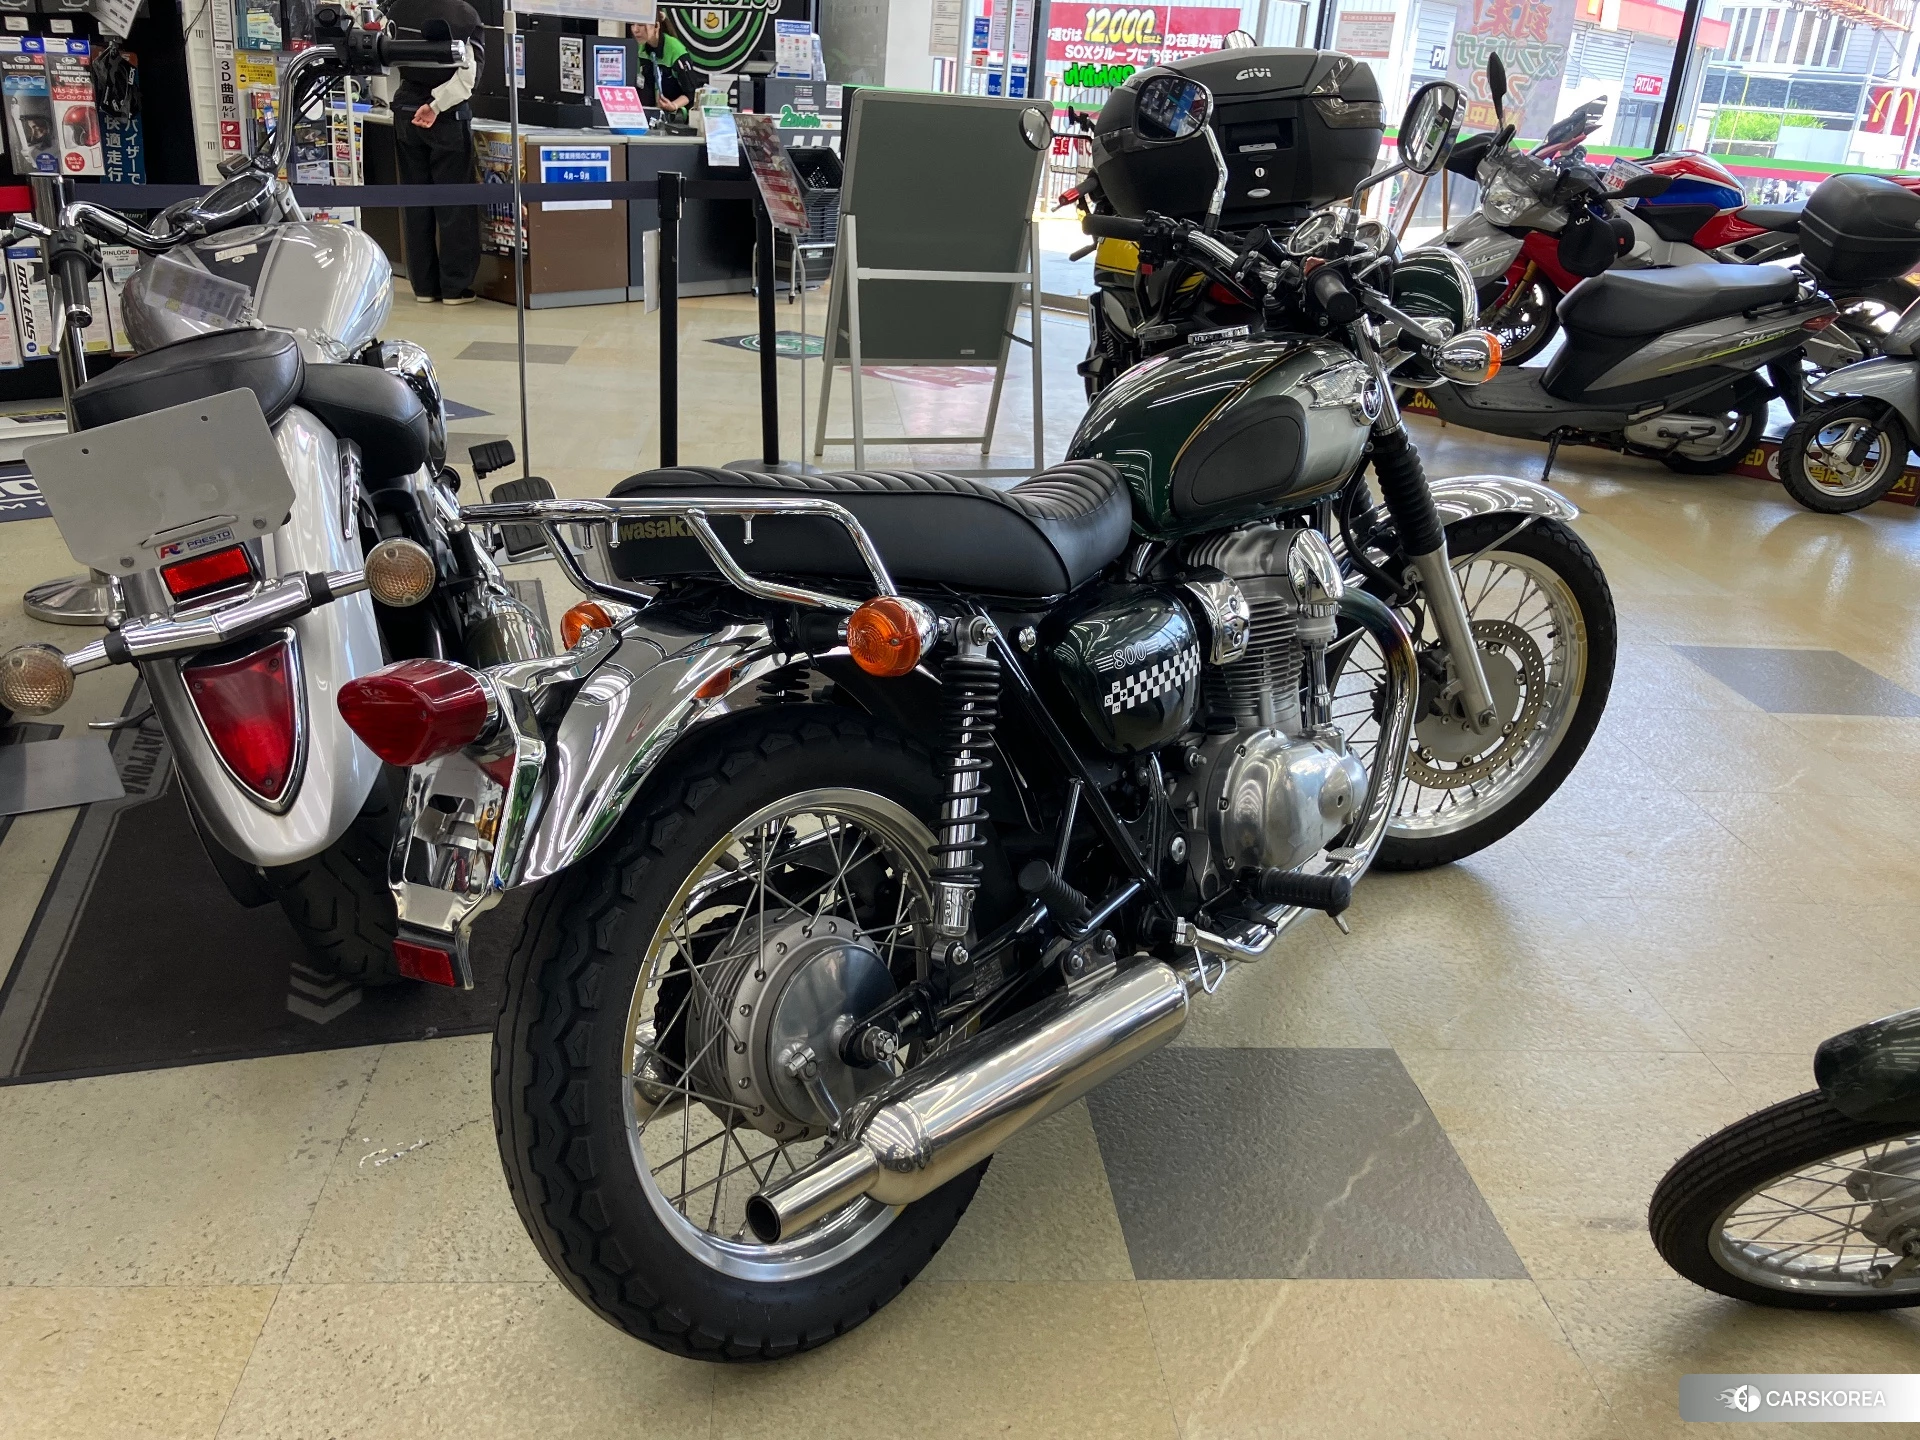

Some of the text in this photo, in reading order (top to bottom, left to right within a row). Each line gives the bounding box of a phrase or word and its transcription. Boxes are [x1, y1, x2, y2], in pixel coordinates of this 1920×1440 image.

[1235, 67, 1272, 81] GIVI
[602, 88, 635, 102] 休止中
[102, 249, 130, 257] PINLOCK
[186, 529, 231, 549] PRESTO
[1112, 641, 1146, 670] 800
